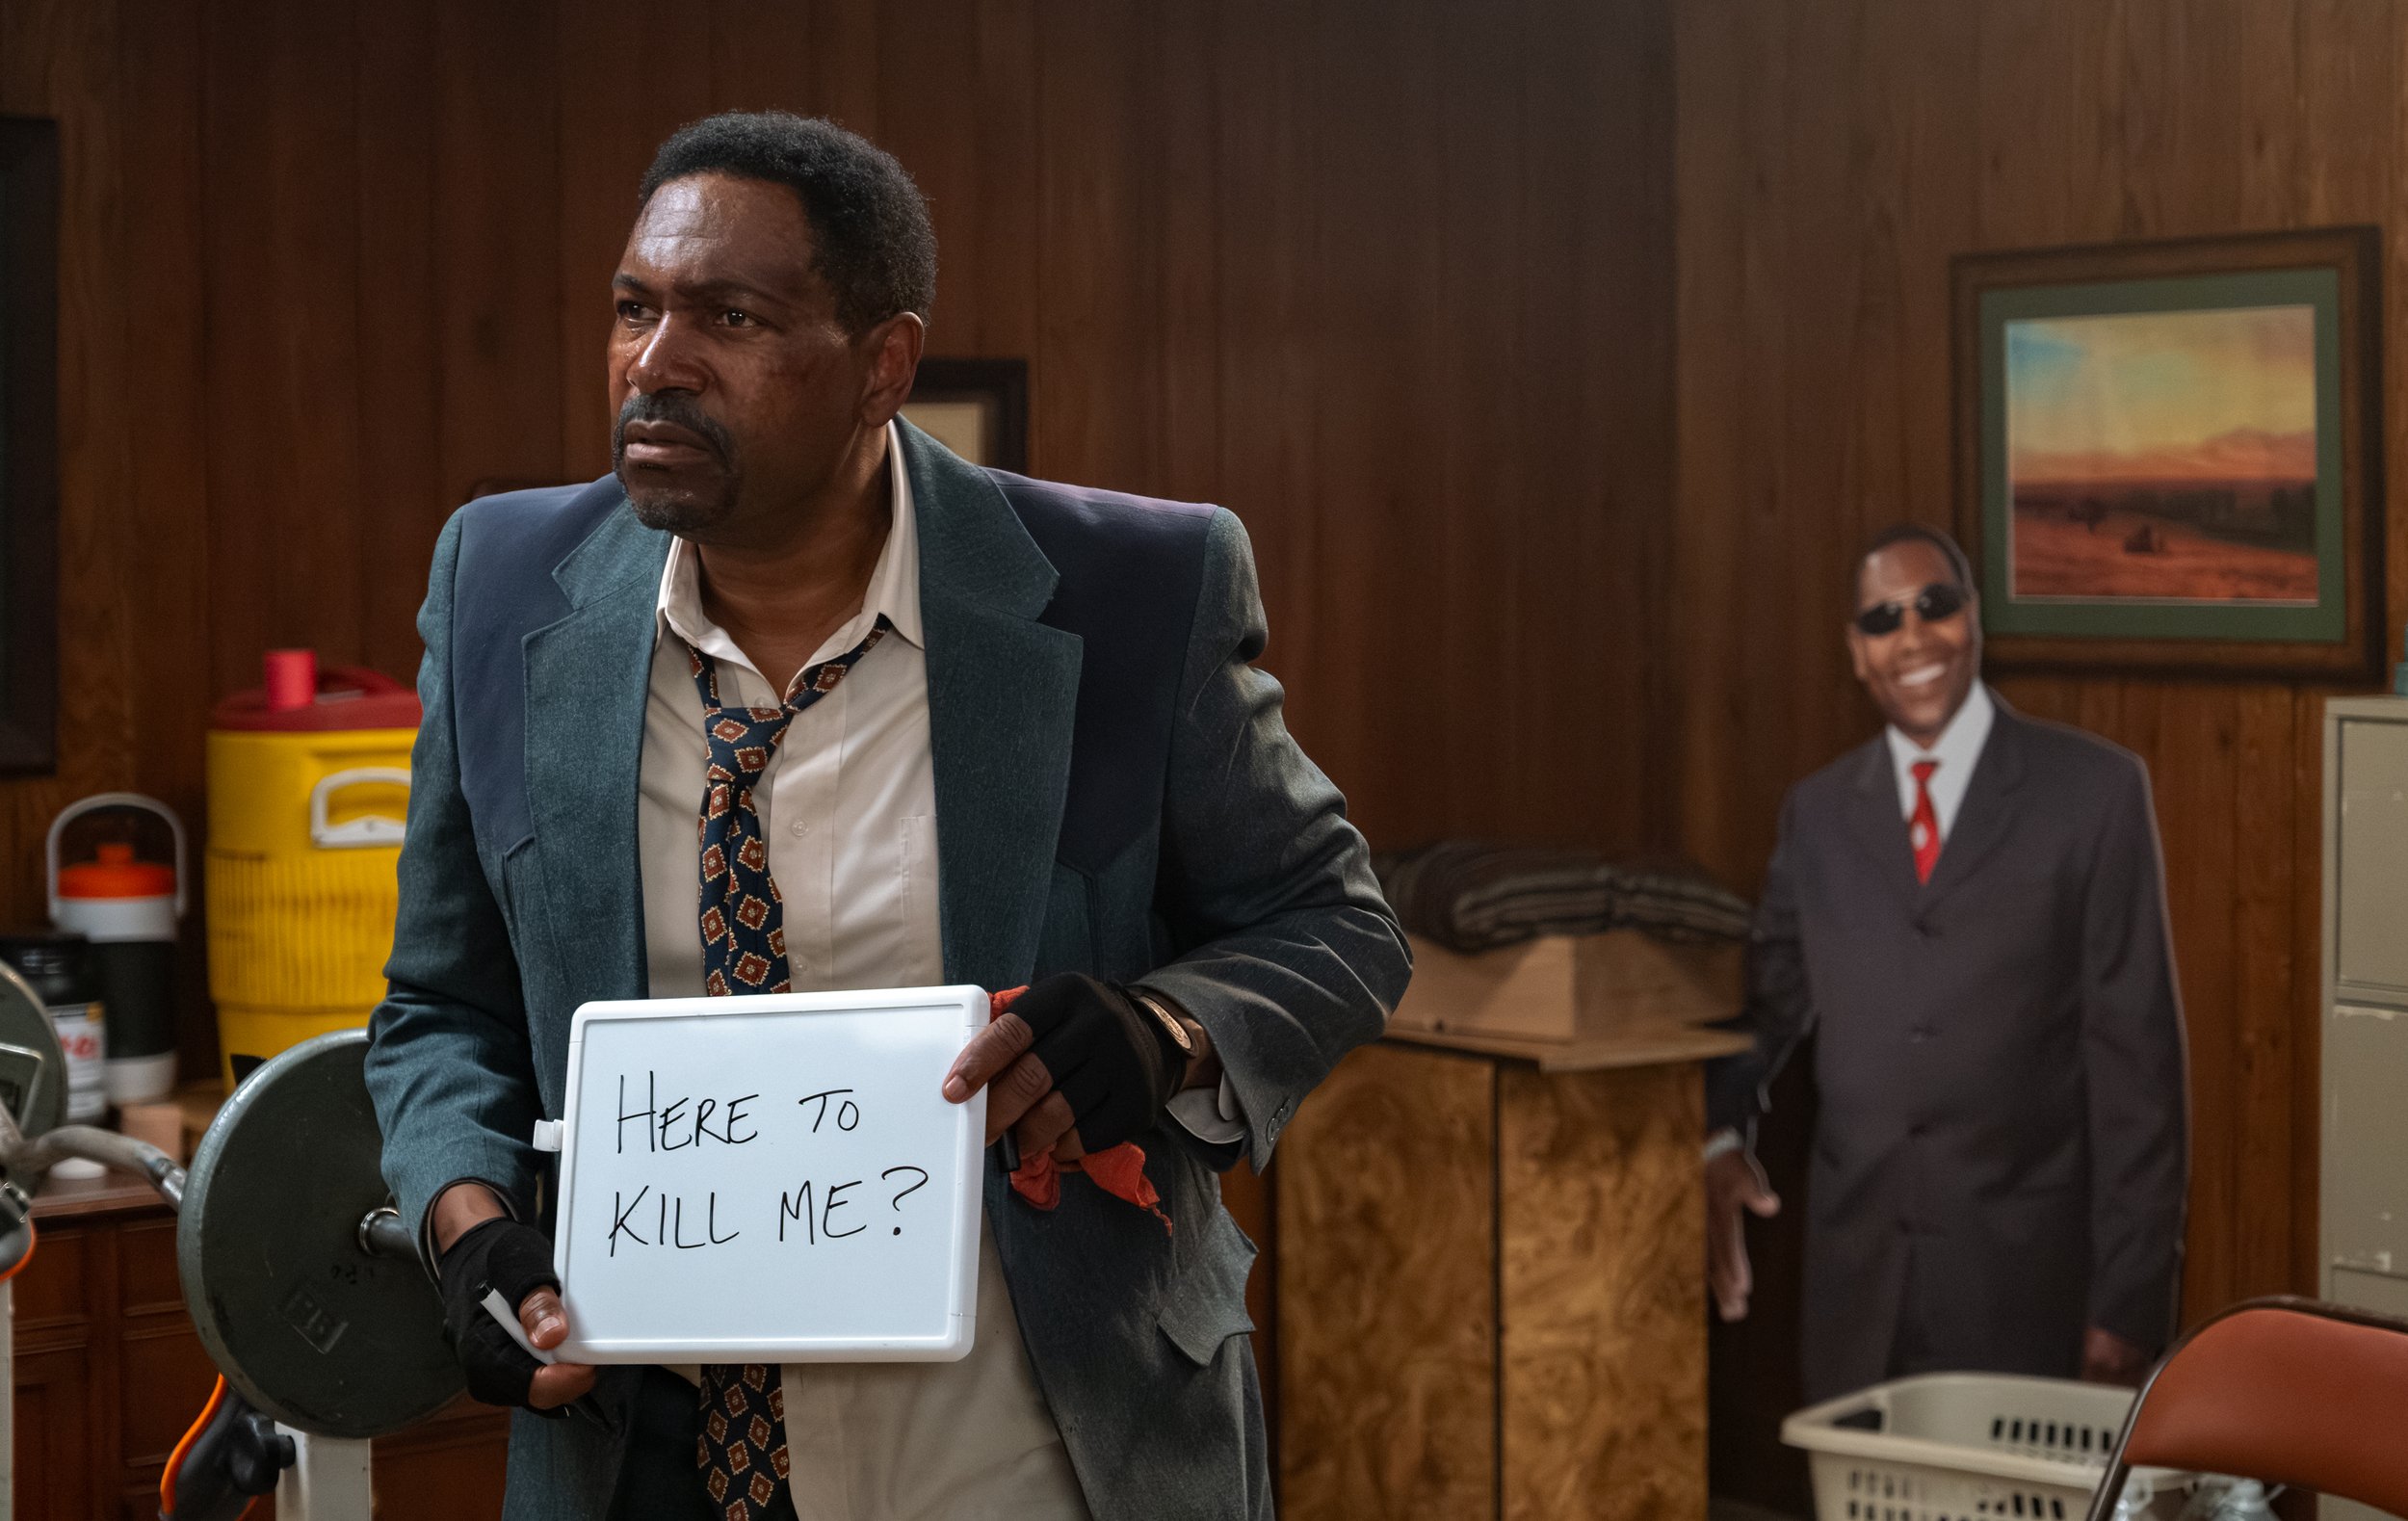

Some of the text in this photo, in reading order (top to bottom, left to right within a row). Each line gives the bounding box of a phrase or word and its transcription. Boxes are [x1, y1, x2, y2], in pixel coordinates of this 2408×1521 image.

[615, 1070, 860, 1154] HERE TO
[608, 1166, 929, 1258] KILL ME?
